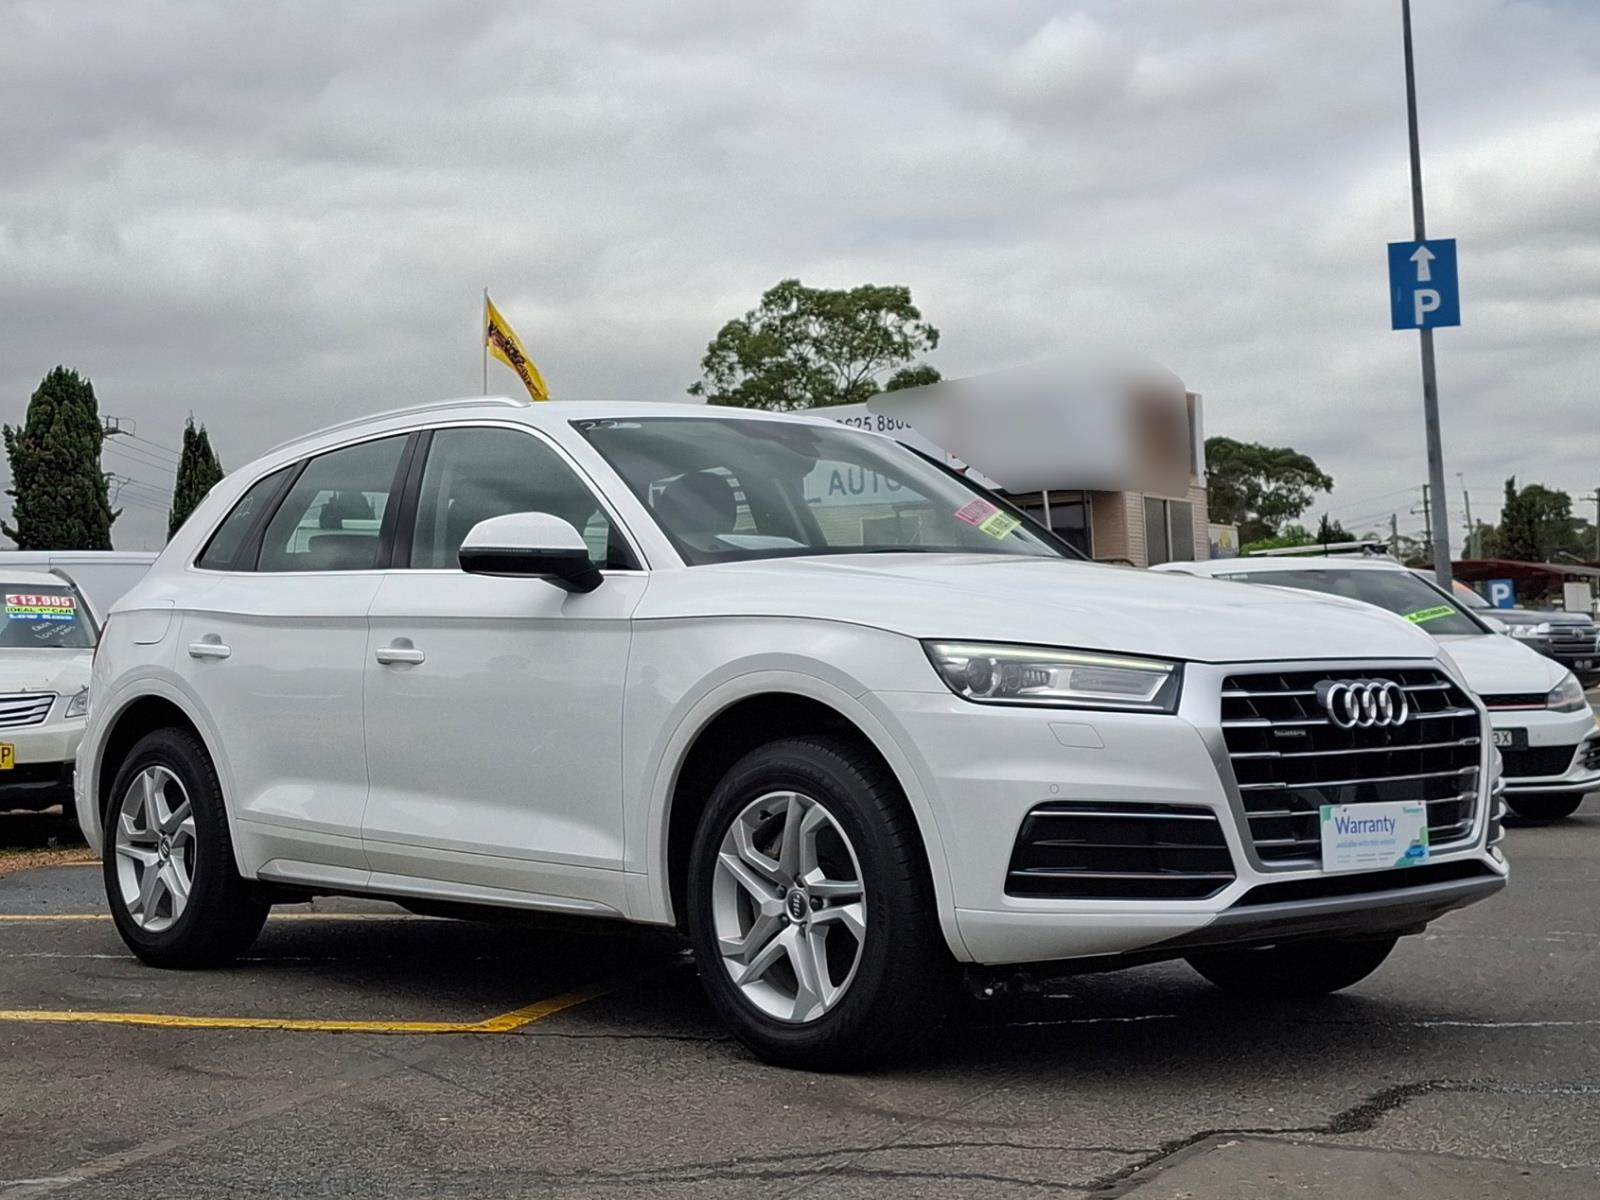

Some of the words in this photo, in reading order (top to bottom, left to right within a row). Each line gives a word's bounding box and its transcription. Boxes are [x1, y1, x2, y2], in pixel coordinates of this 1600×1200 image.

[1414, 289, 1440, 325] P
[1492, 583, 1510, 608] P
[1335, 816, 1396, 835] Warranty
